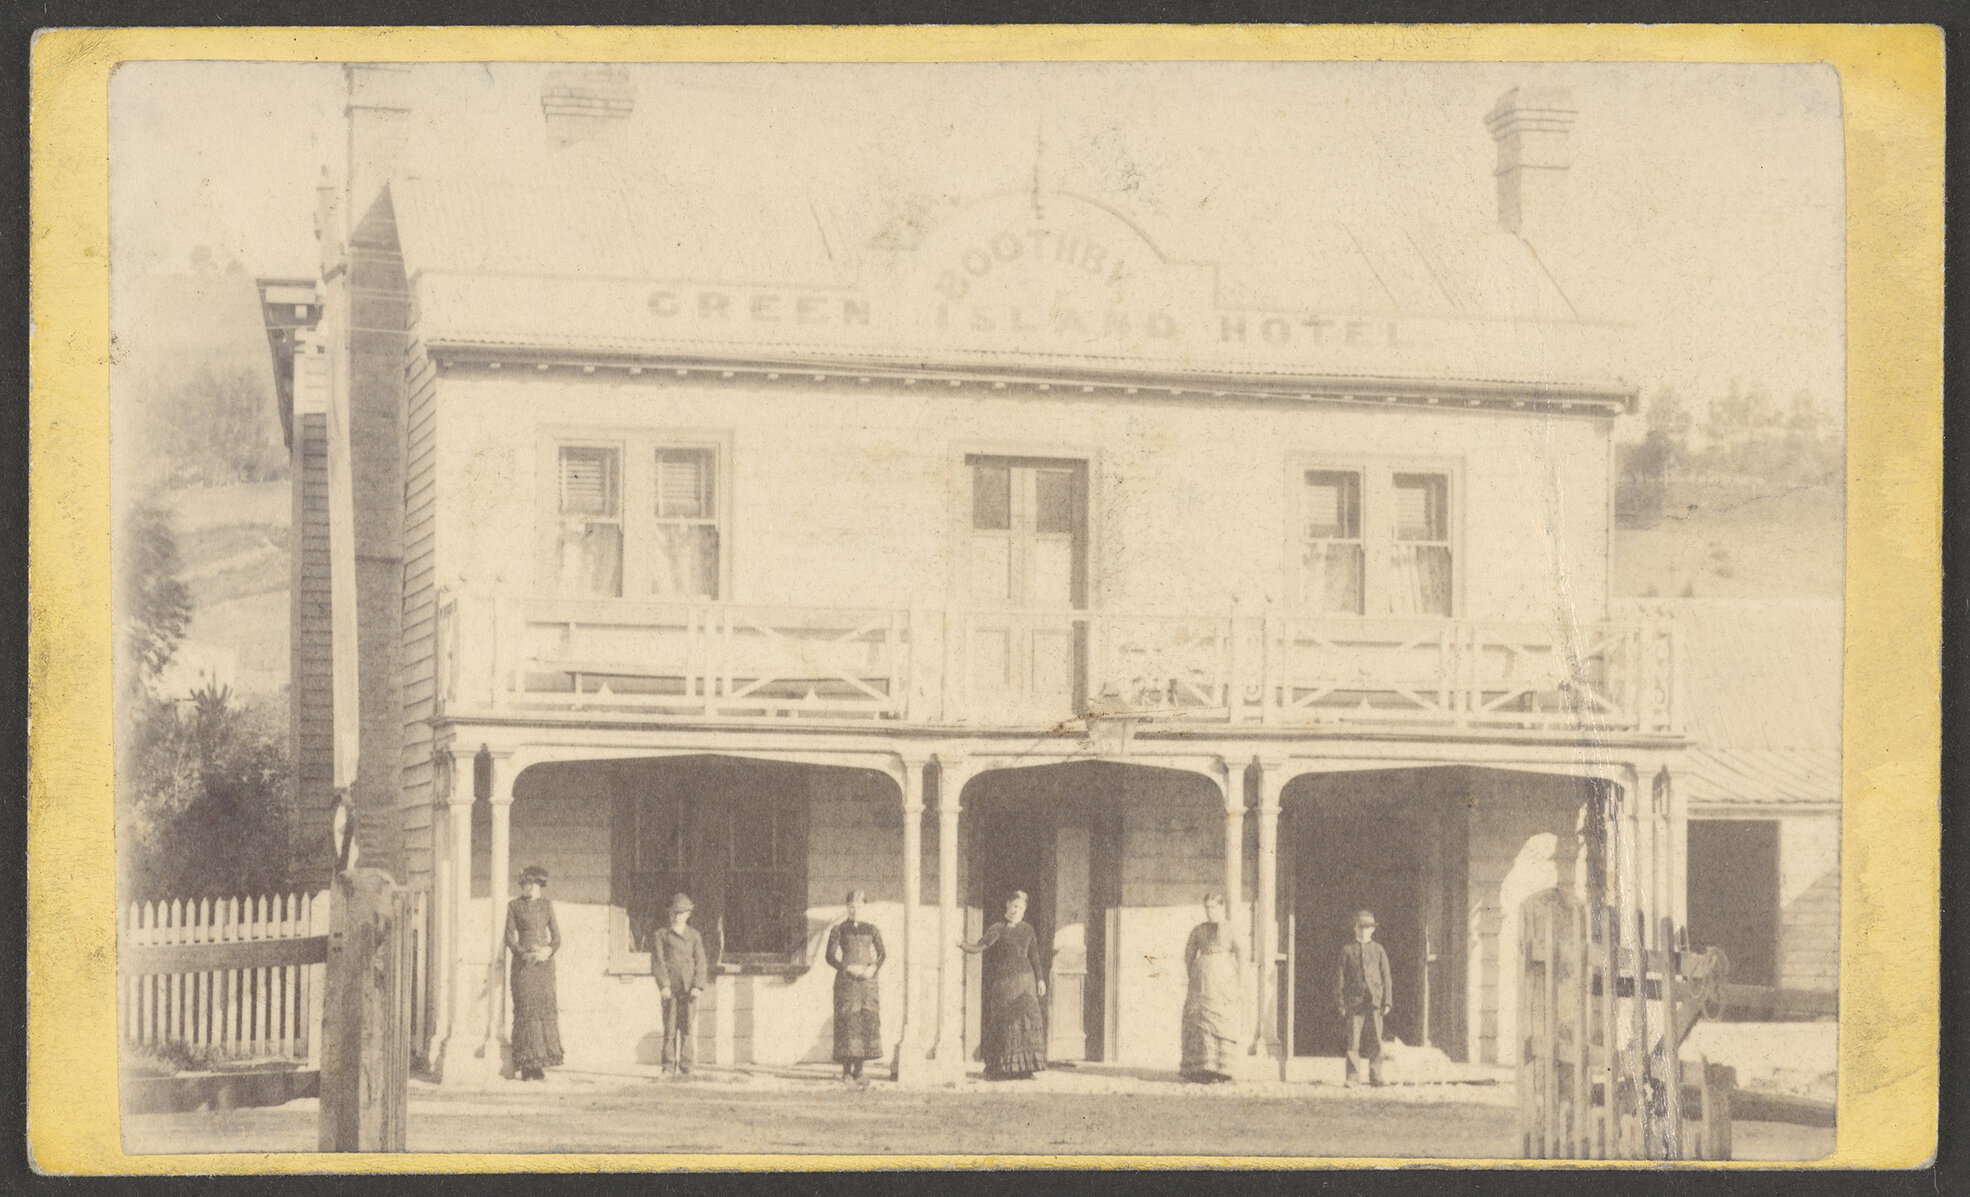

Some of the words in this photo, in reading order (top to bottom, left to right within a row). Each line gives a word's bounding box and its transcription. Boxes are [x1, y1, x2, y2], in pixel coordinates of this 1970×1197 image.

[647, 289, 871, 326] GREEN
[936, 303, 1179, 339] ISLAND
[1219, 315, 1407, 348] HOTEL
